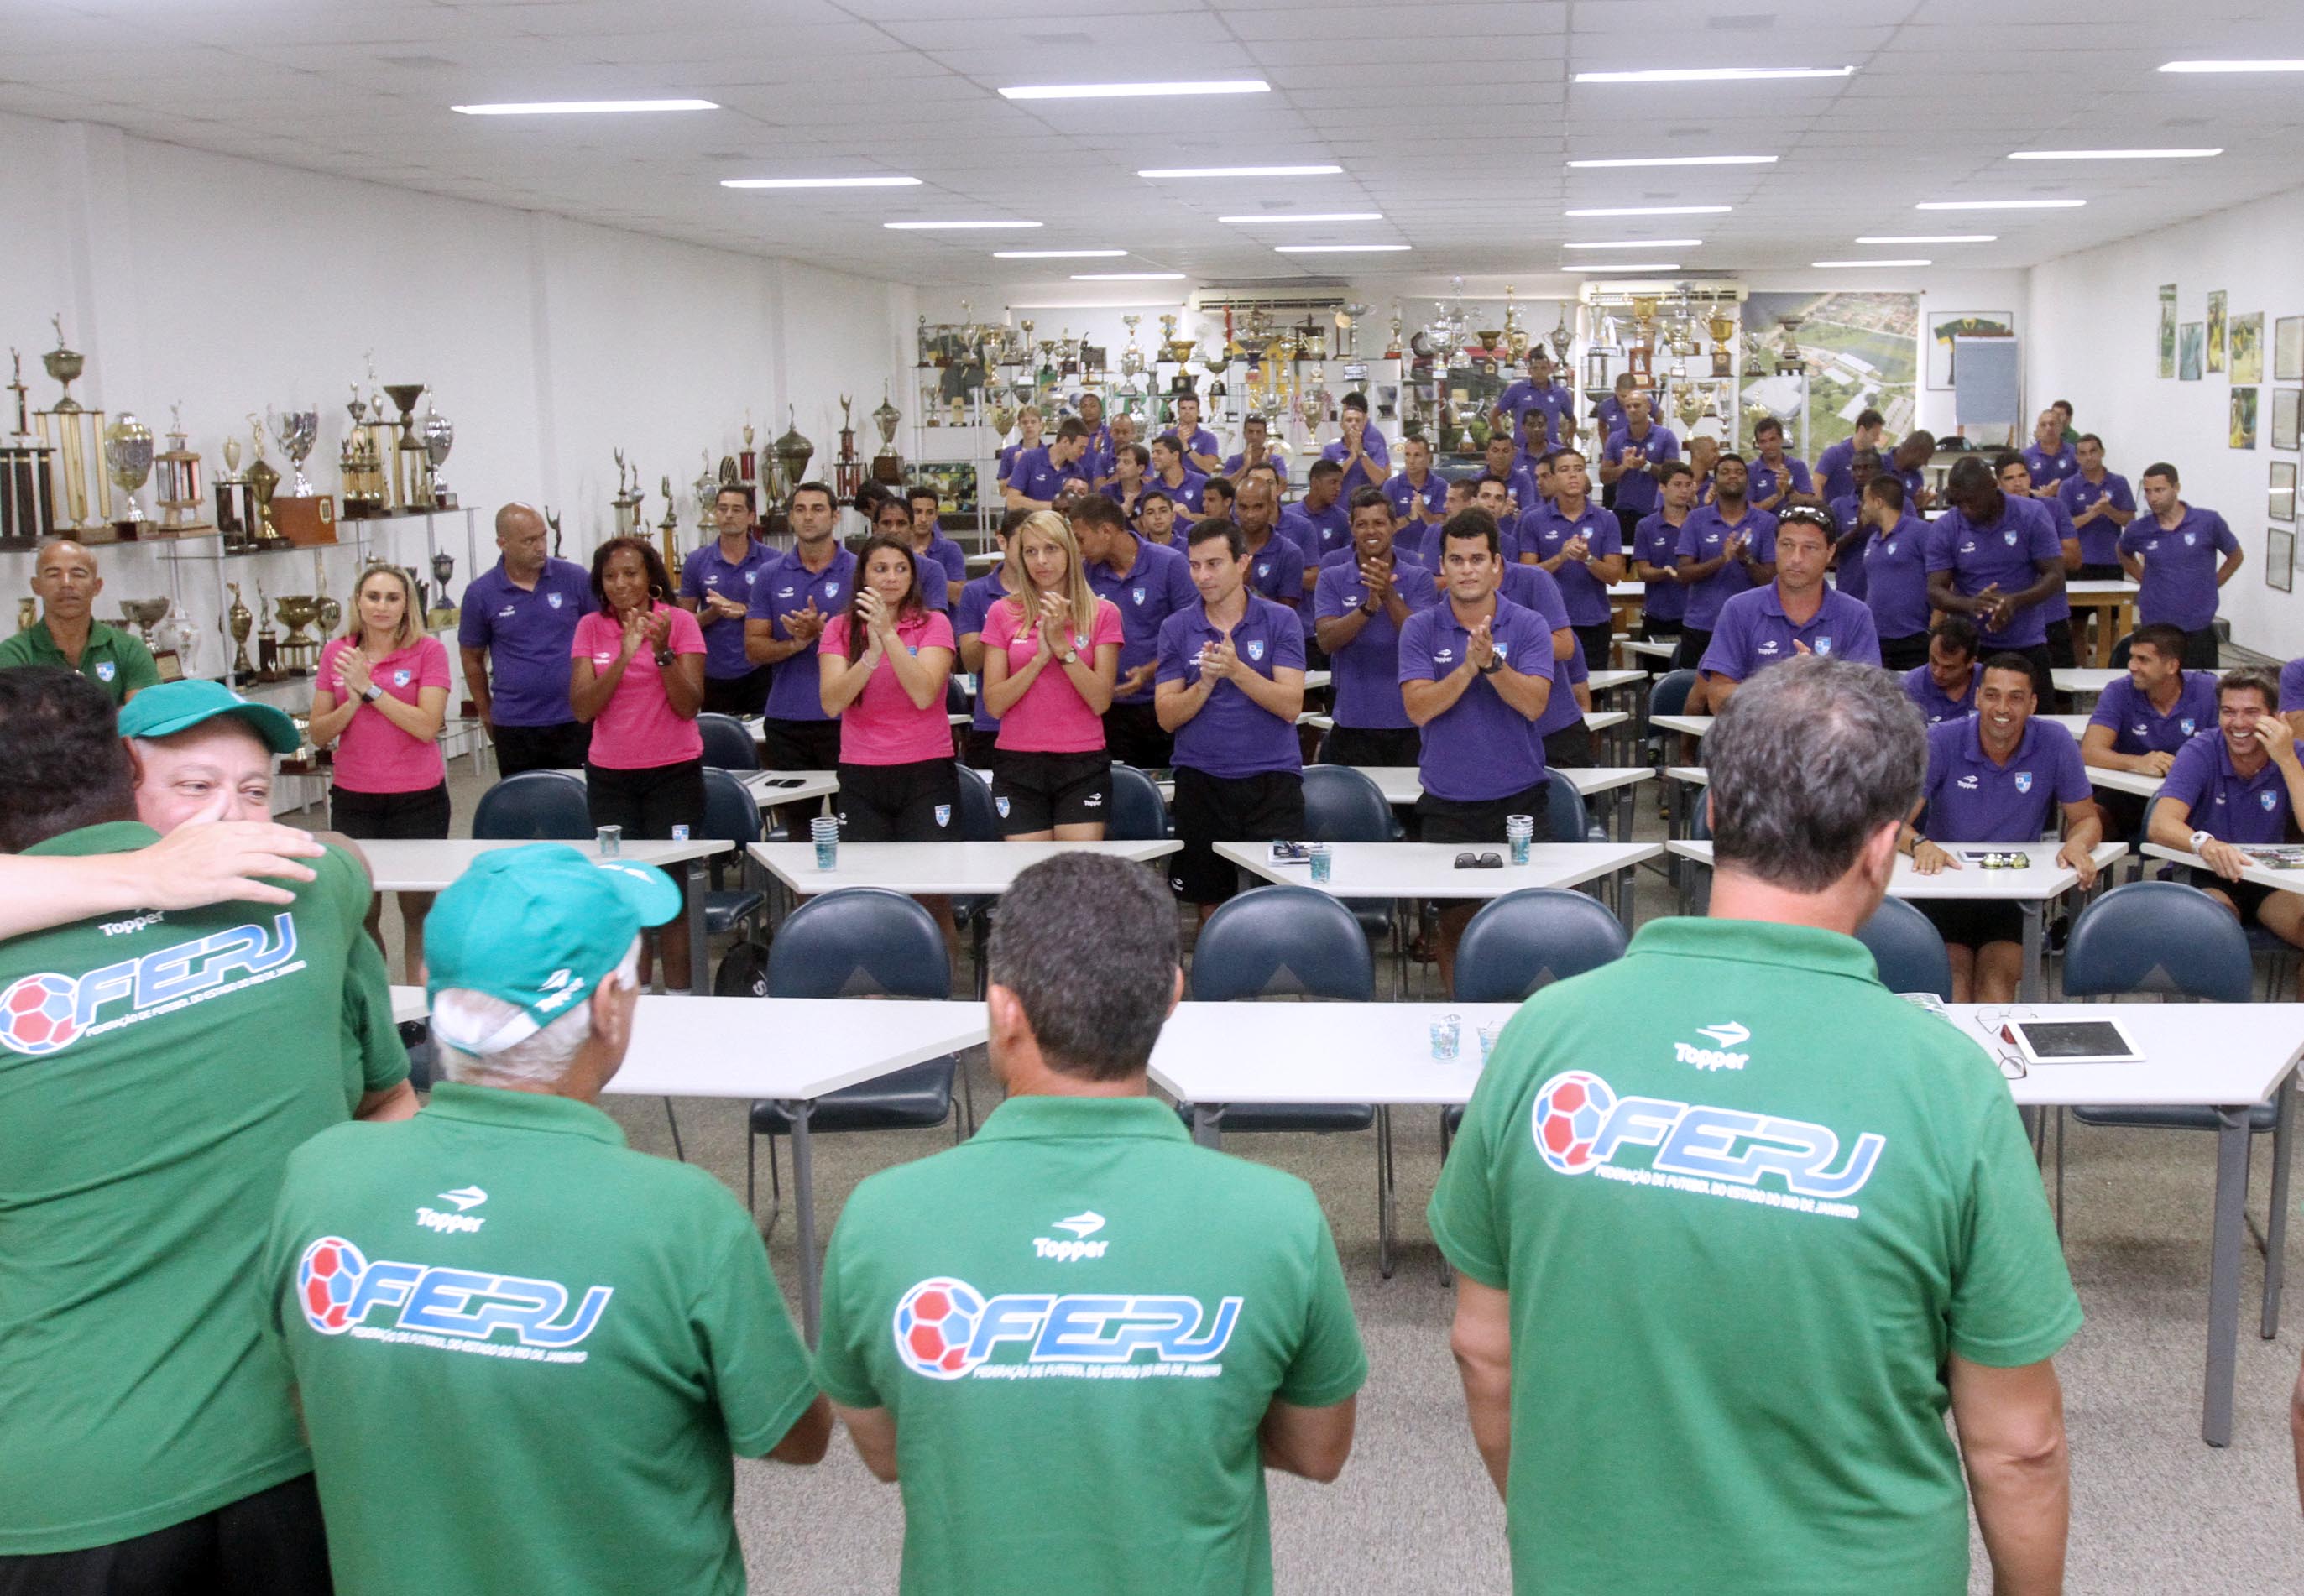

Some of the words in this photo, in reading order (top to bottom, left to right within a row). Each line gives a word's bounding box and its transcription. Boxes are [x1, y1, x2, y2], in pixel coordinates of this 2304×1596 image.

[97, 911, 164, 936] Topper
[72, 912, 297, 1029] FERJ
[1674, 1042, 1749, 1072] Topper
[1586, 1096, 1886, 1198] FERJ
[416, 1207, 486, 1234] Topper
[1032, 1238, 1109, 1262] Topper
[343, 1260, 614, 1348] FERJ
[963, 1294, 1245, 1363] FERJ
